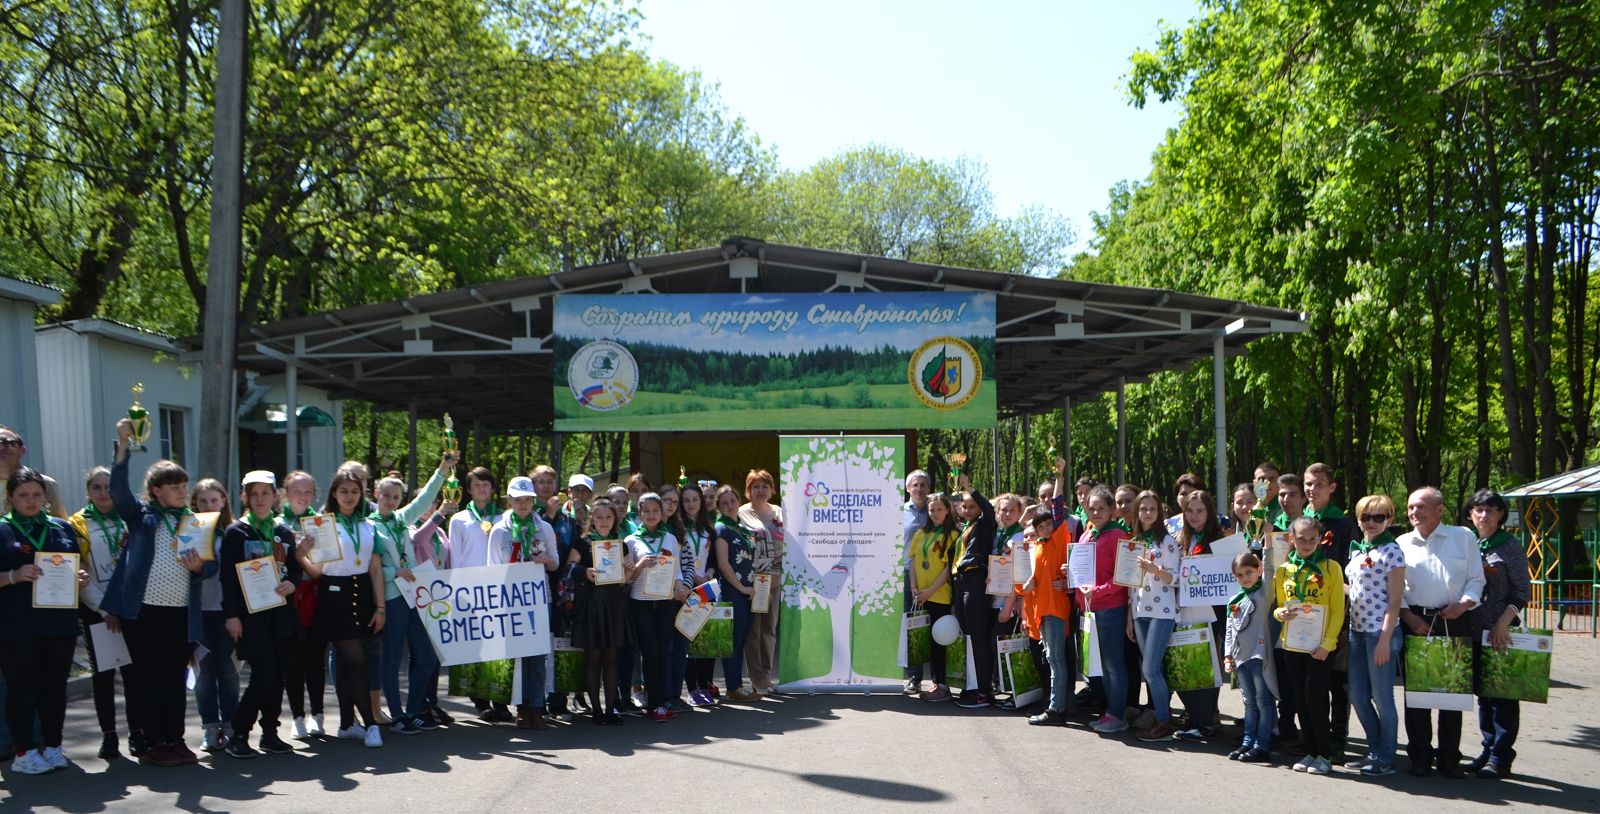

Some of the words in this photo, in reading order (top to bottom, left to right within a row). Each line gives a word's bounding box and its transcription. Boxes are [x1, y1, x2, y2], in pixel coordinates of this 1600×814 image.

[581, 304, 692, 334] Сохраним
[700, 308, 798, 333] природу
[806, 302, 967, 333] Ставрополья!
[831, 494, 882, 508] СДЕЛАЕМ
[813, 509, 863, 523] ВМЕСТЕ!
[455, 580, 548, 614] СДЕЛАЕМ
[1189, 585, 1228, 598] ВМЕСТЕ!
